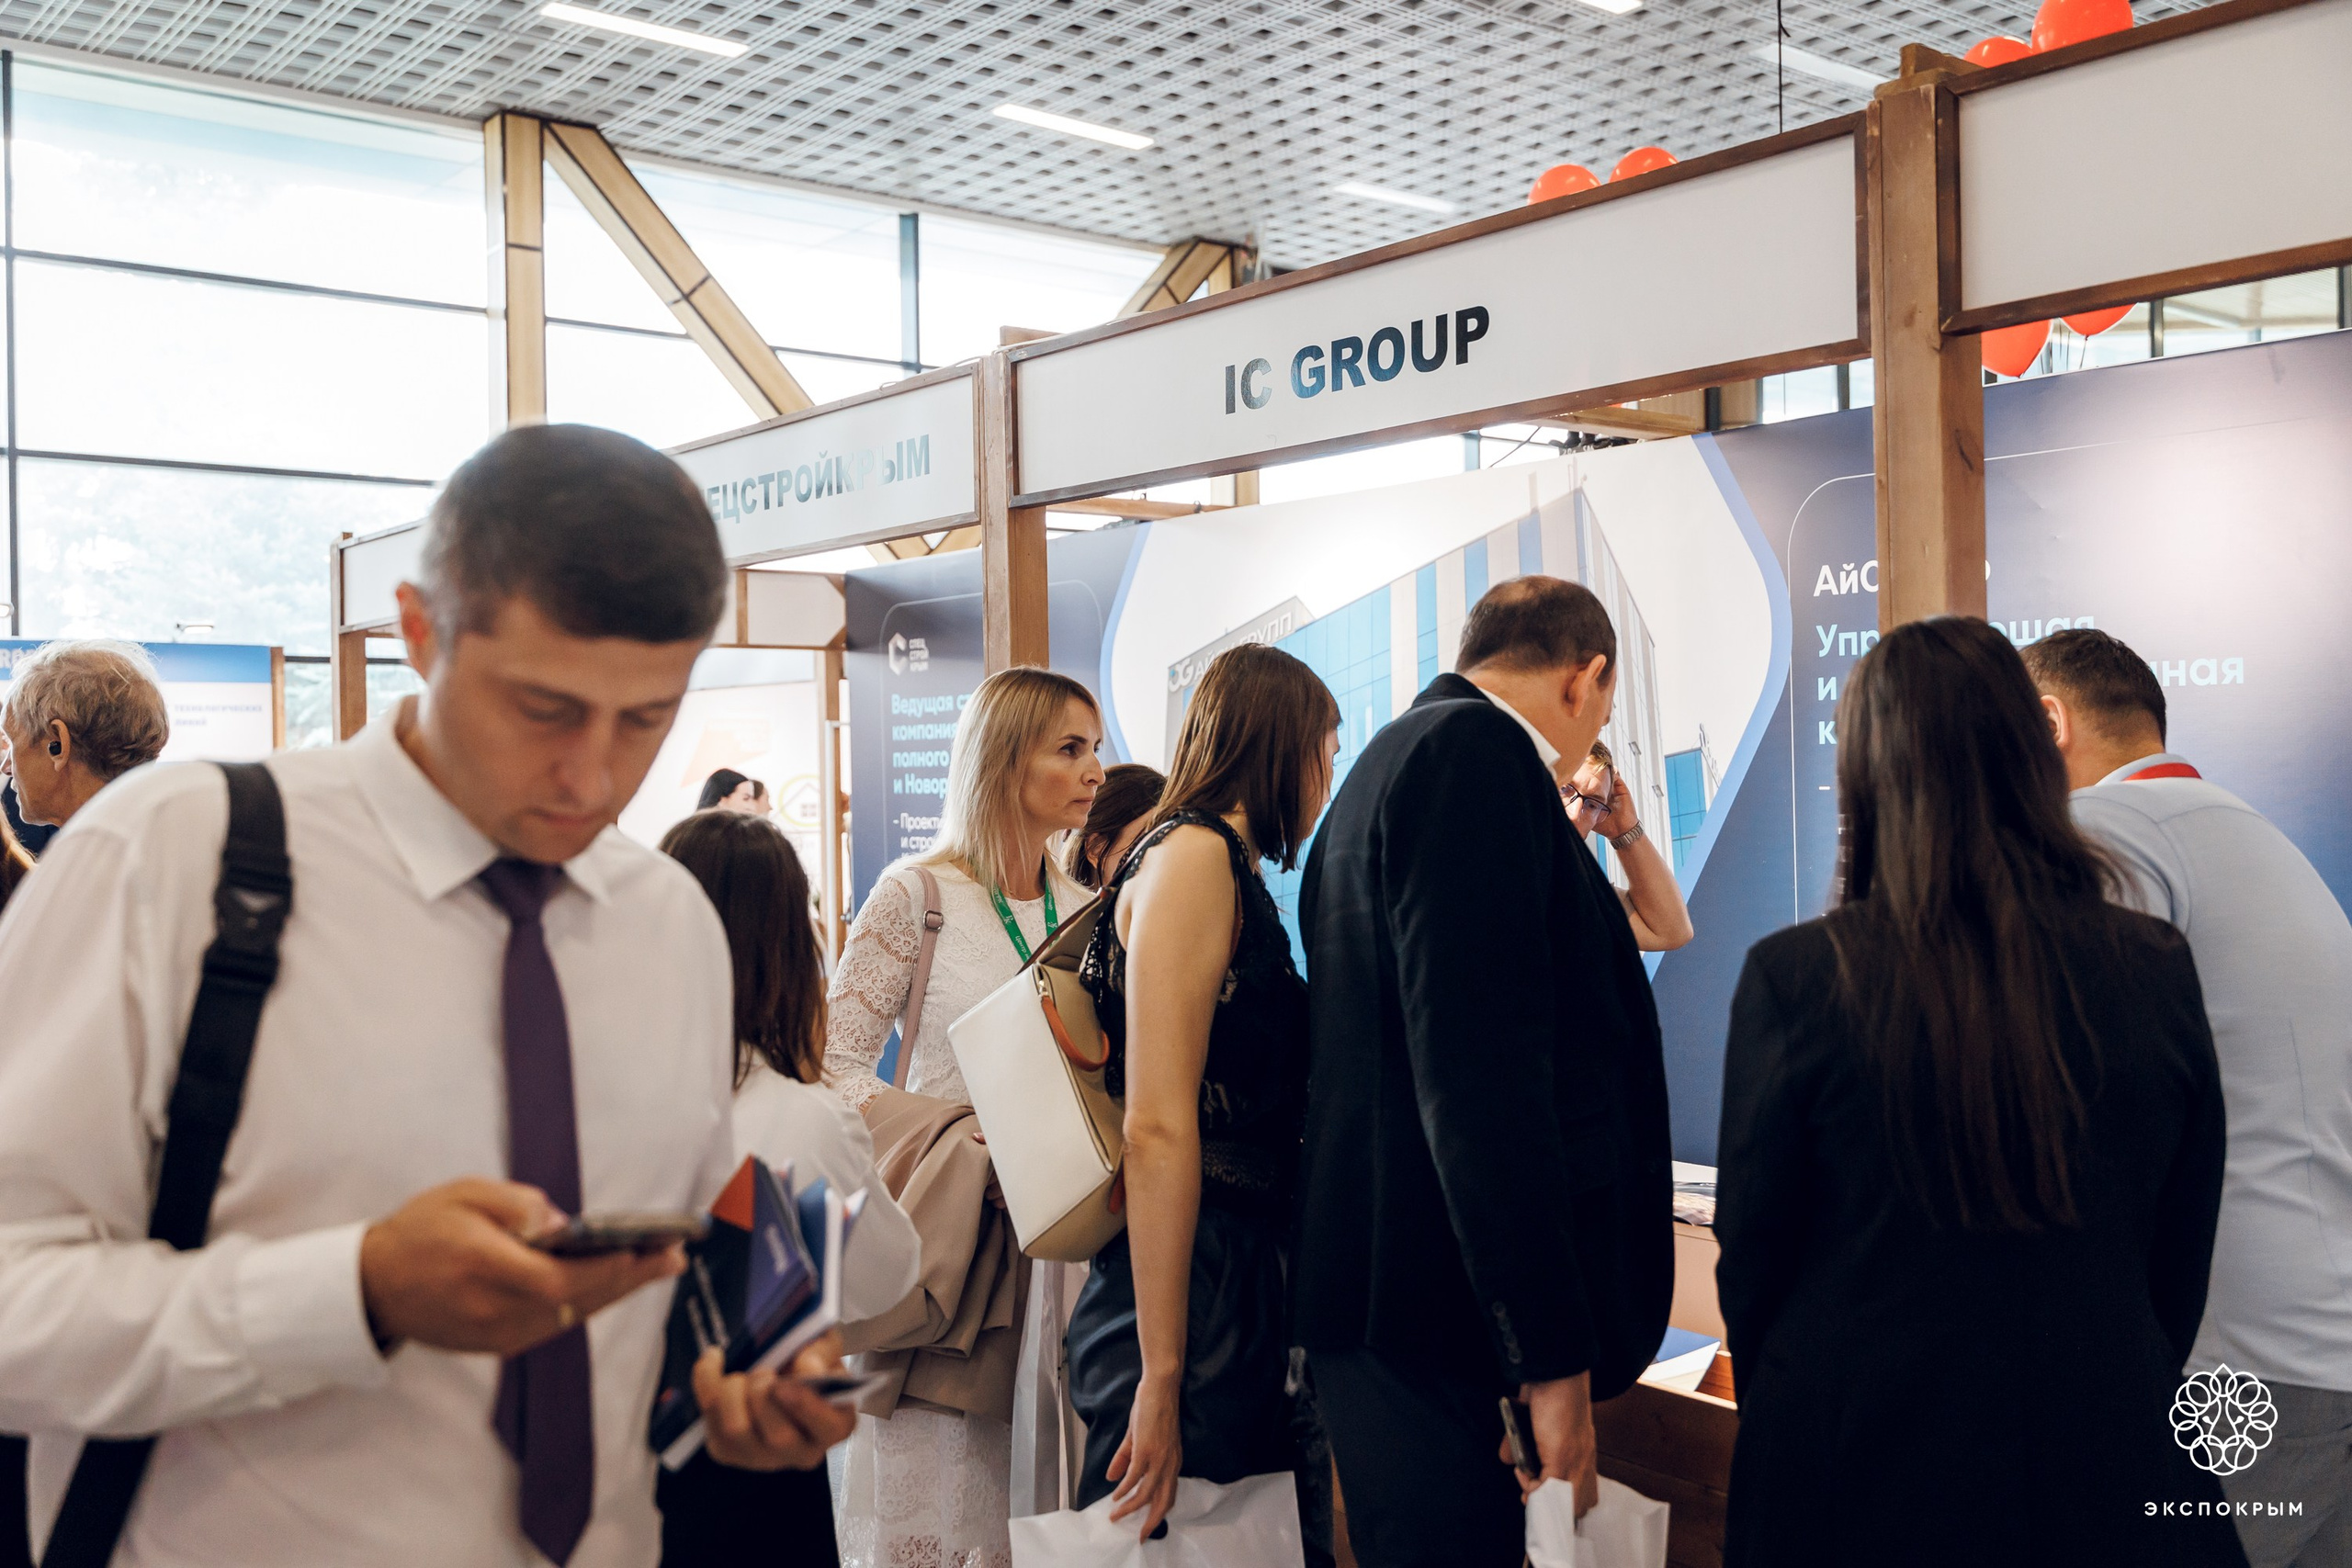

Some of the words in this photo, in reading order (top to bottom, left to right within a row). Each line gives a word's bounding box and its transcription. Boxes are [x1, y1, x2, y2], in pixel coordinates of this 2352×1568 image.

[1225, 357, 1272, 415] IC
[1290, 305, 1489, 399] GROUP
[704, 434, 930, 524] ЕЦСТРОЙКРЫМ
[1813, 559, 1878, 597] АйС
[891, 694, 954, 717] Ведущая
[893, 750, 951, 768] полного
[893, 778, 903, 795] и
[905, 773, 948, 799] Новор
